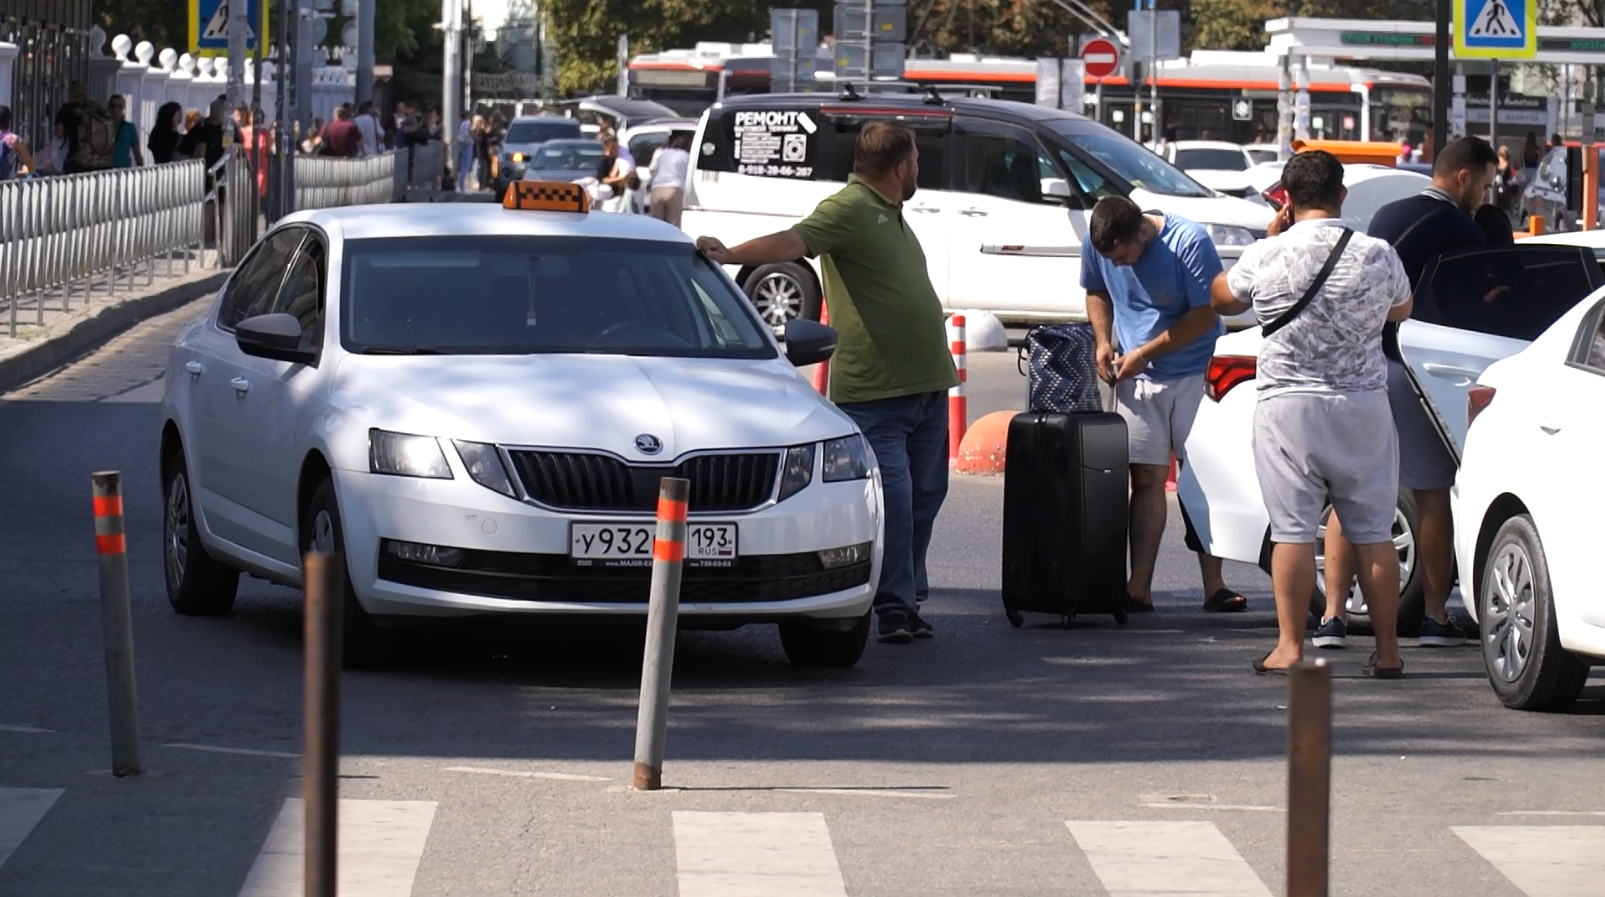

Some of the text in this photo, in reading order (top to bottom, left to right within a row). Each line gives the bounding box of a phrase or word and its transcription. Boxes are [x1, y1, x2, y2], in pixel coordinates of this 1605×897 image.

[735, 111, 798, 126] РЕМОНТ
[691, 527, 728, 547] 193
[698, 547, 718, 556] RUS
